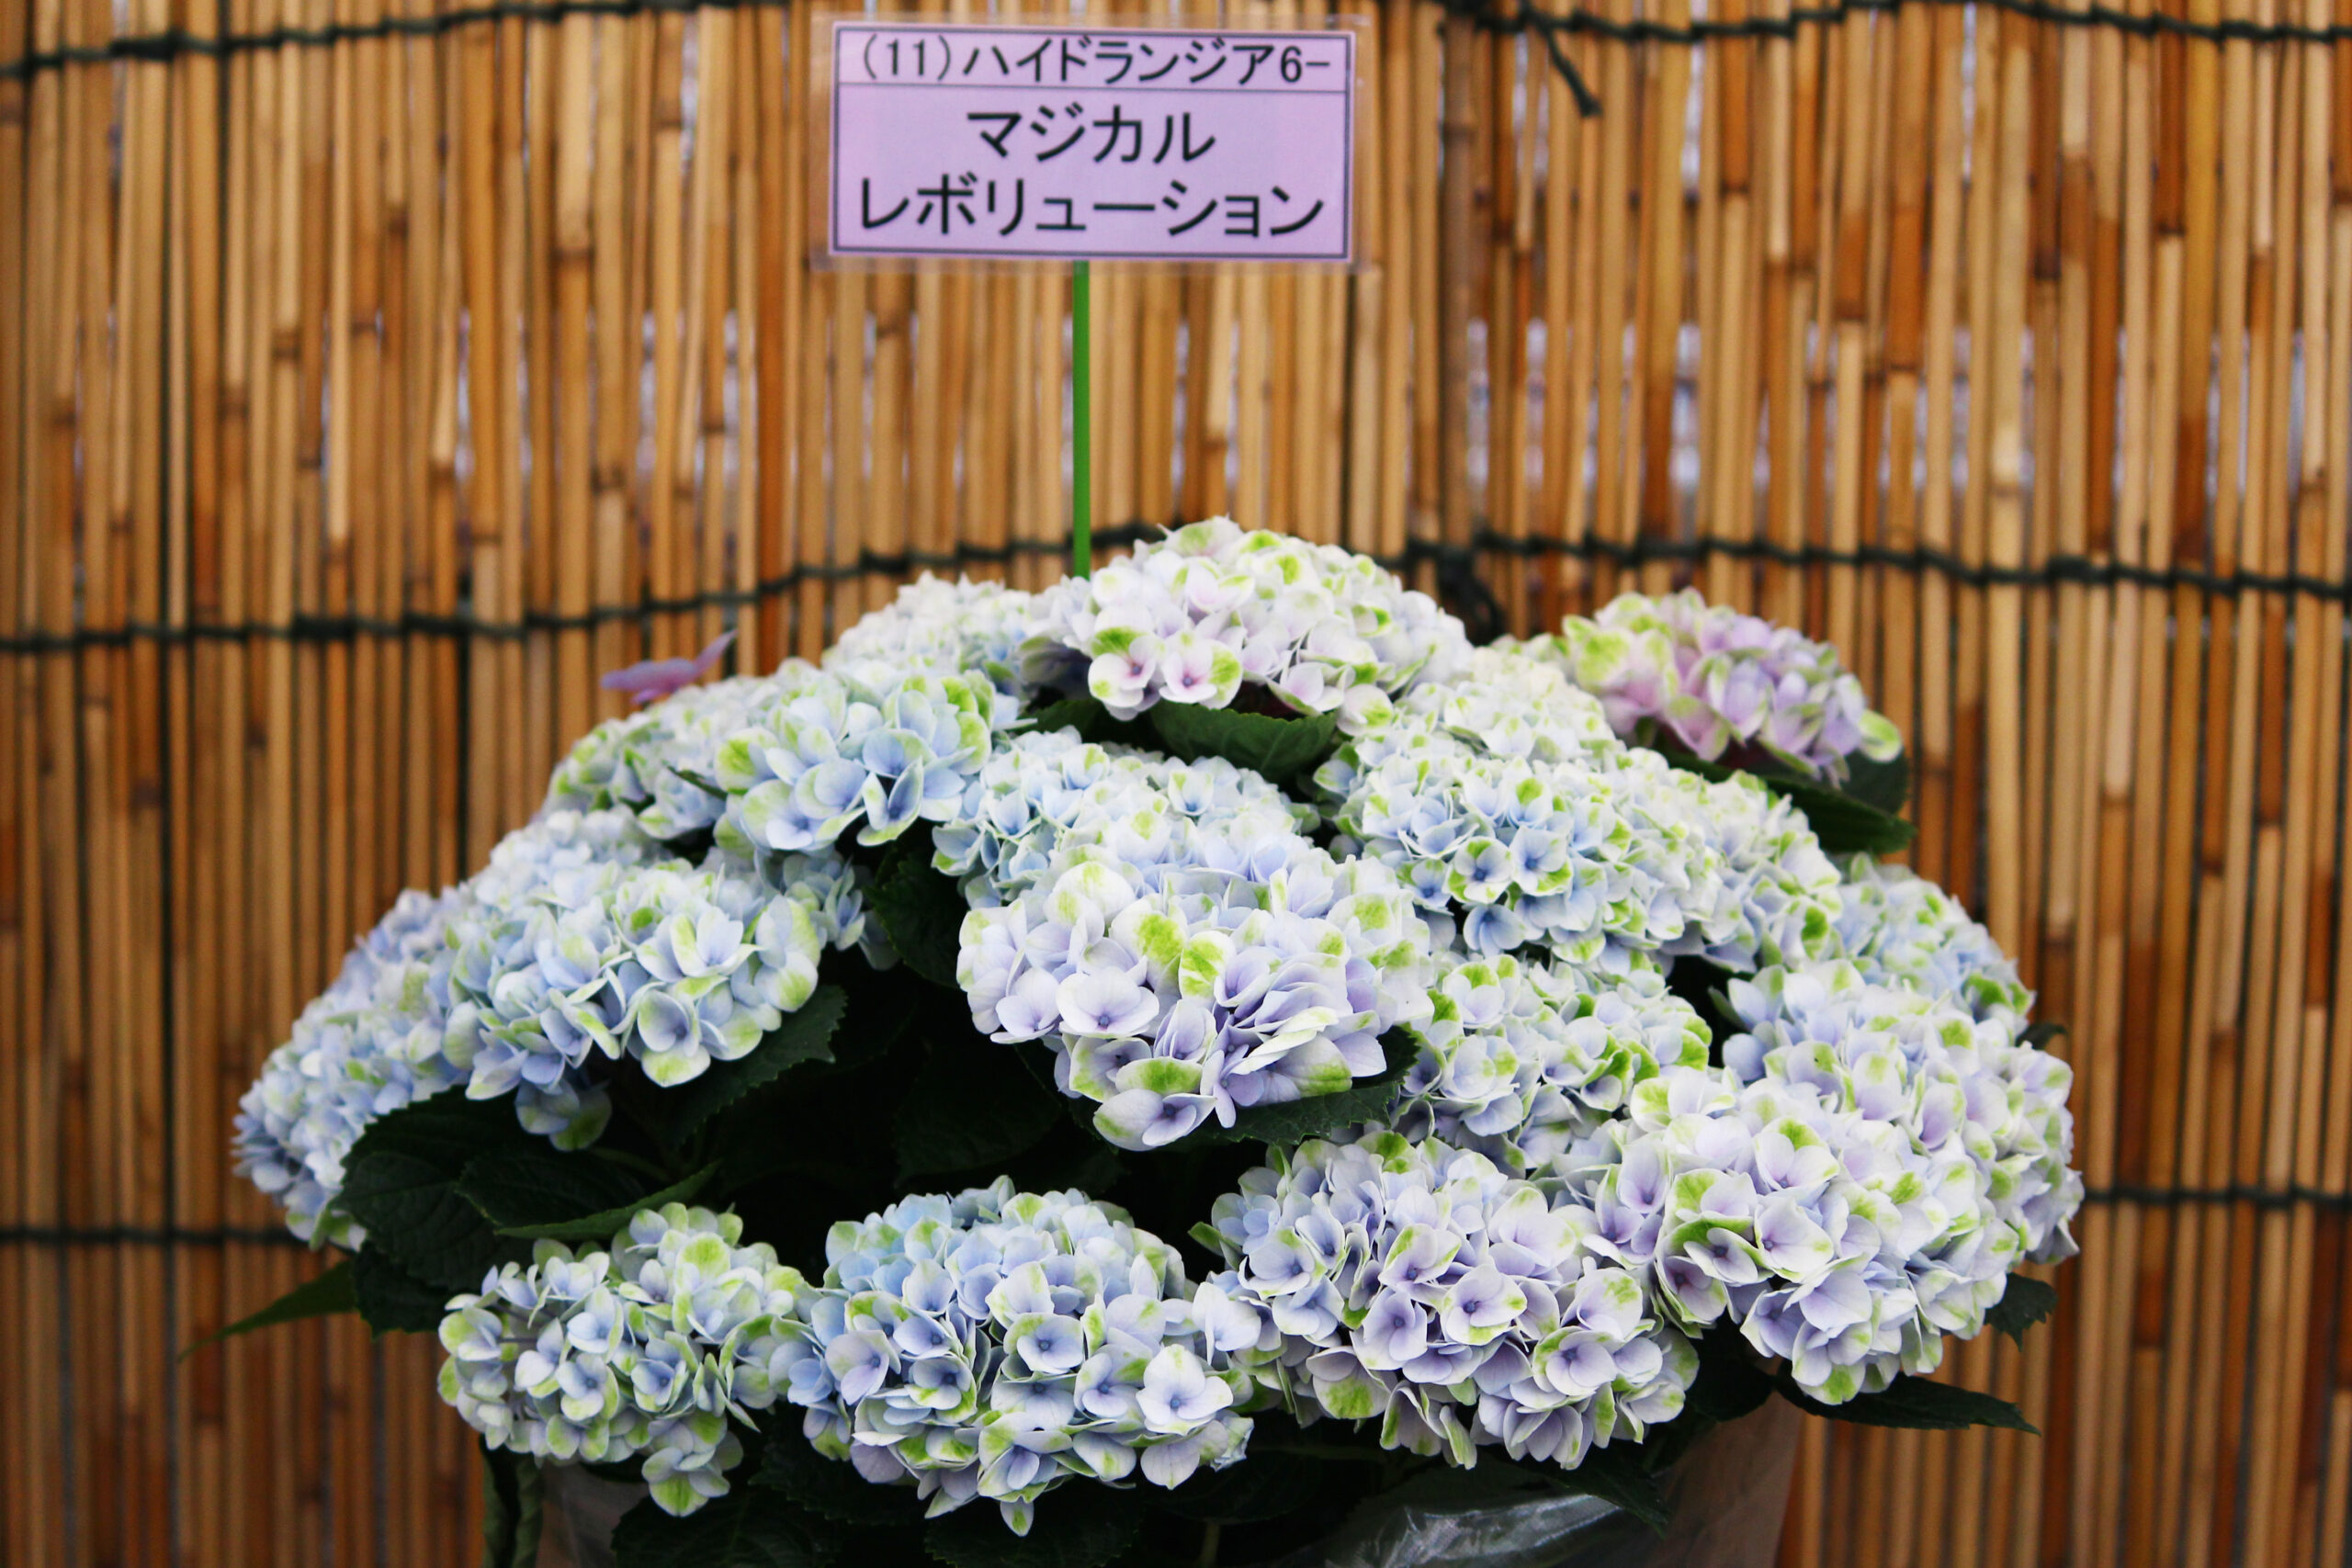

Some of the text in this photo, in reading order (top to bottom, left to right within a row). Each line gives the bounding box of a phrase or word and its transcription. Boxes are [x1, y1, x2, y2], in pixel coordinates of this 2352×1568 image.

[967, 101, 1216, 164] マジカル
[861, 171, 1324, 239] レボリューション
